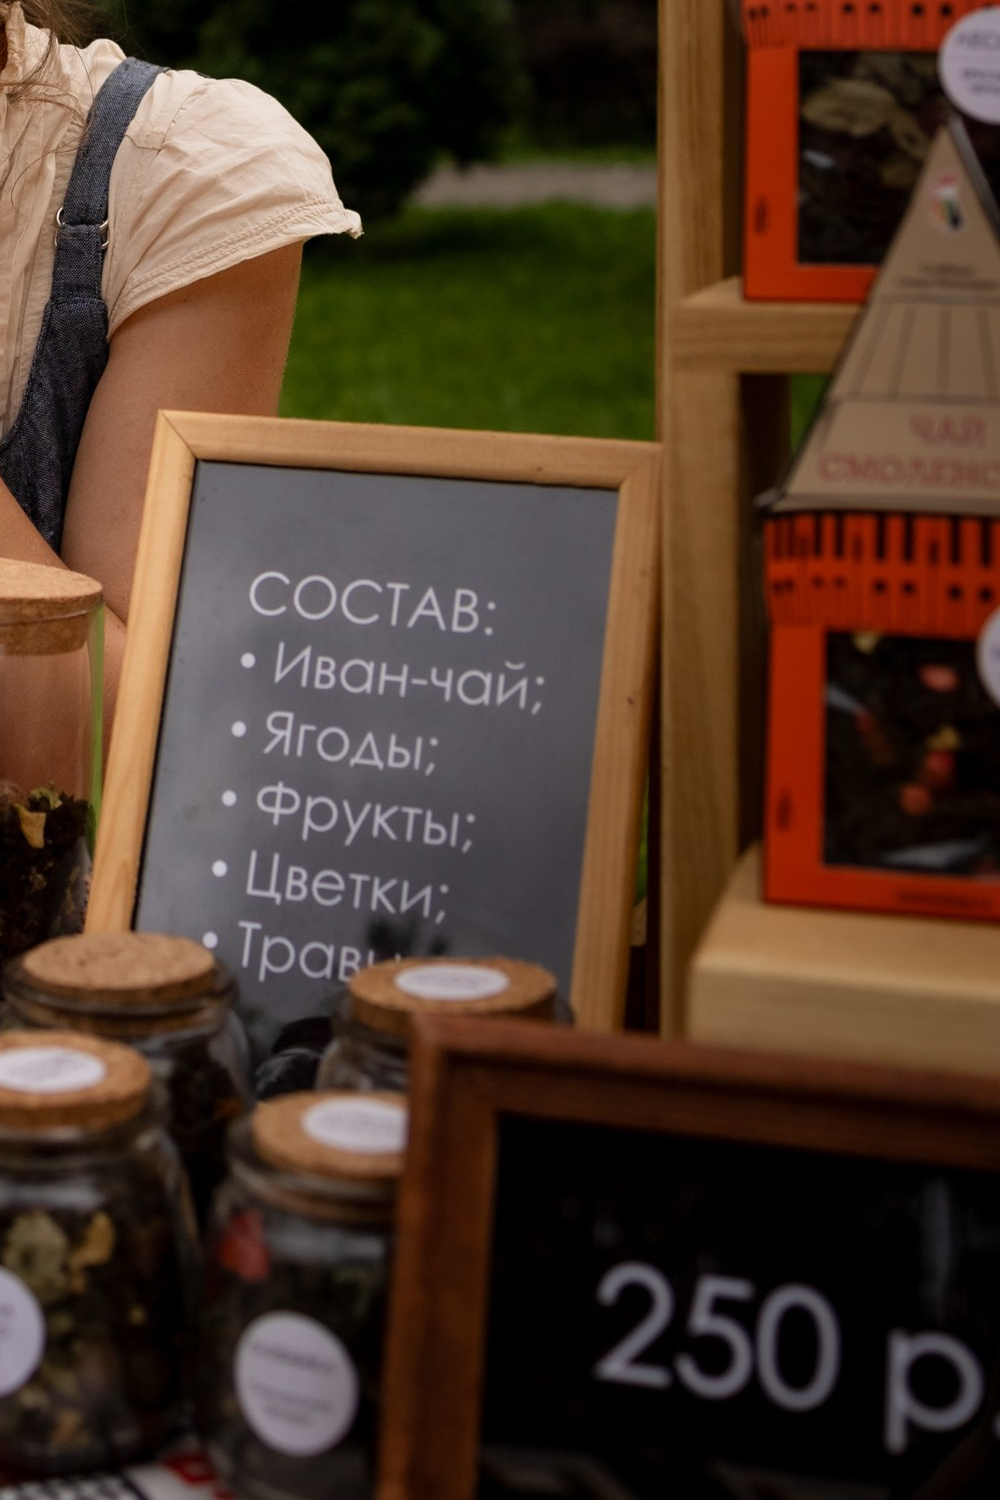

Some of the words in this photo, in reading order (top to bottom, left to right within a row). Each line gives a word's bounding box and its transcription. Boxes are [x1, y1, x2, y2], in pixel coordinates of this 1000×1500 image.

[249, 571, 496, 636] СОСТАВ:
[274, 642, 545, 715] Иван-чай;
[263, 711, 439, 776] Ягоды;
[256, 782, 475, 853] Фрукты;
[246, 849, 449, 925] Цветки;
[595, 1261, 841, 1412] 250
